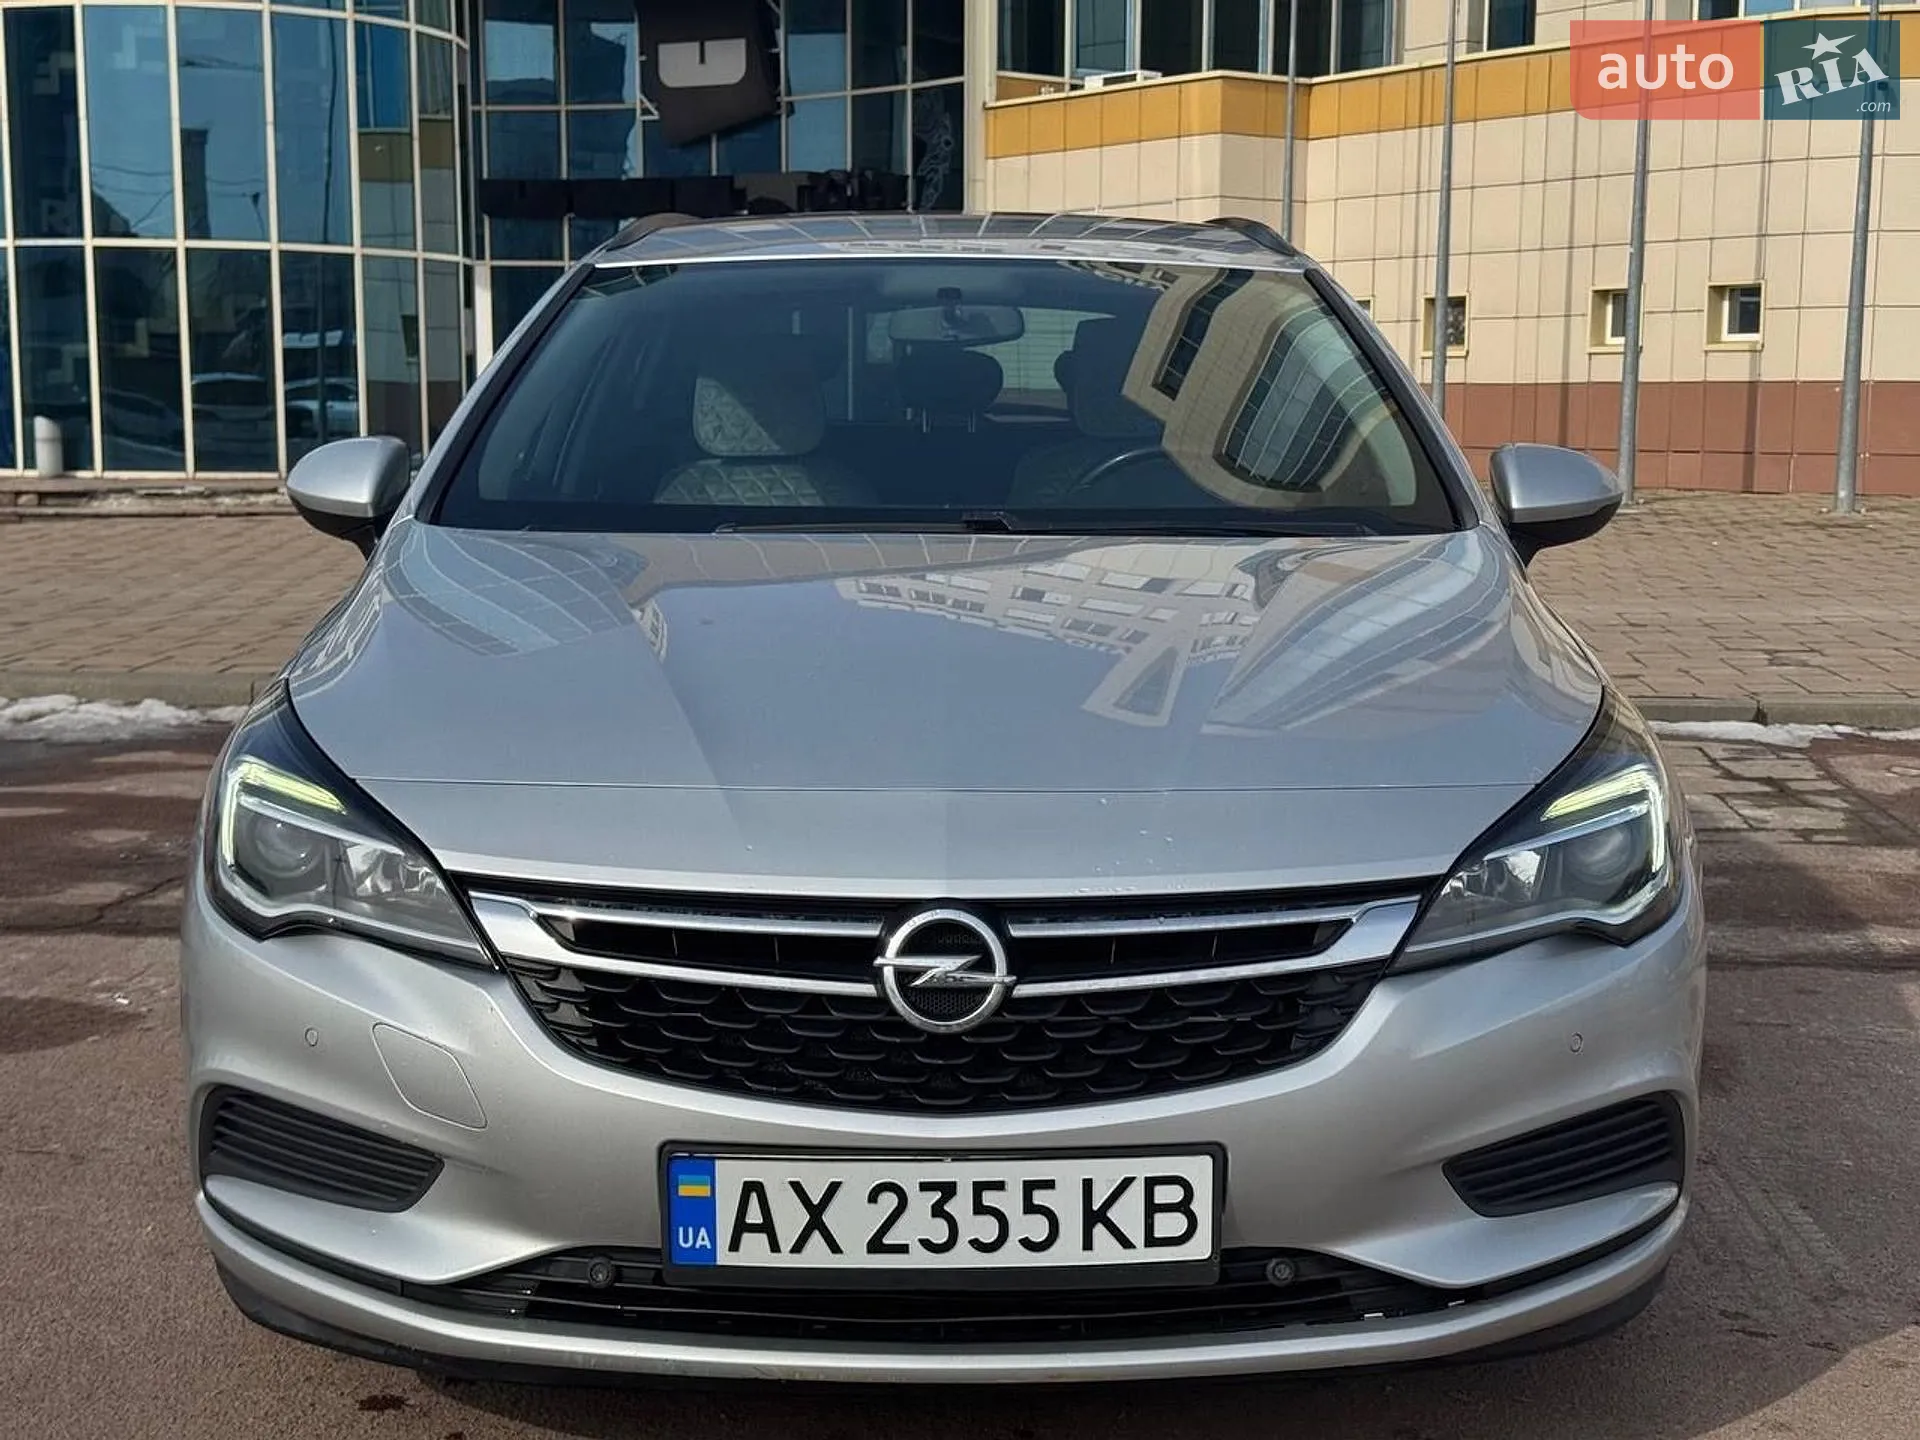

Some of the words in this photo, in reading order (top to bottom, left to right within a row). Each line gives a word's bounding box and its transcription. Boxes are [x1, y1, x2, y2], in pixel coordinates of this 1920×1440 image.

[678, 1227, 711, 1250] UA
[728, 1180, 843, 1255] AX
[865, 1178, 1061, 1255] 2355
[1081, 1175, 1199, 1251] KB
